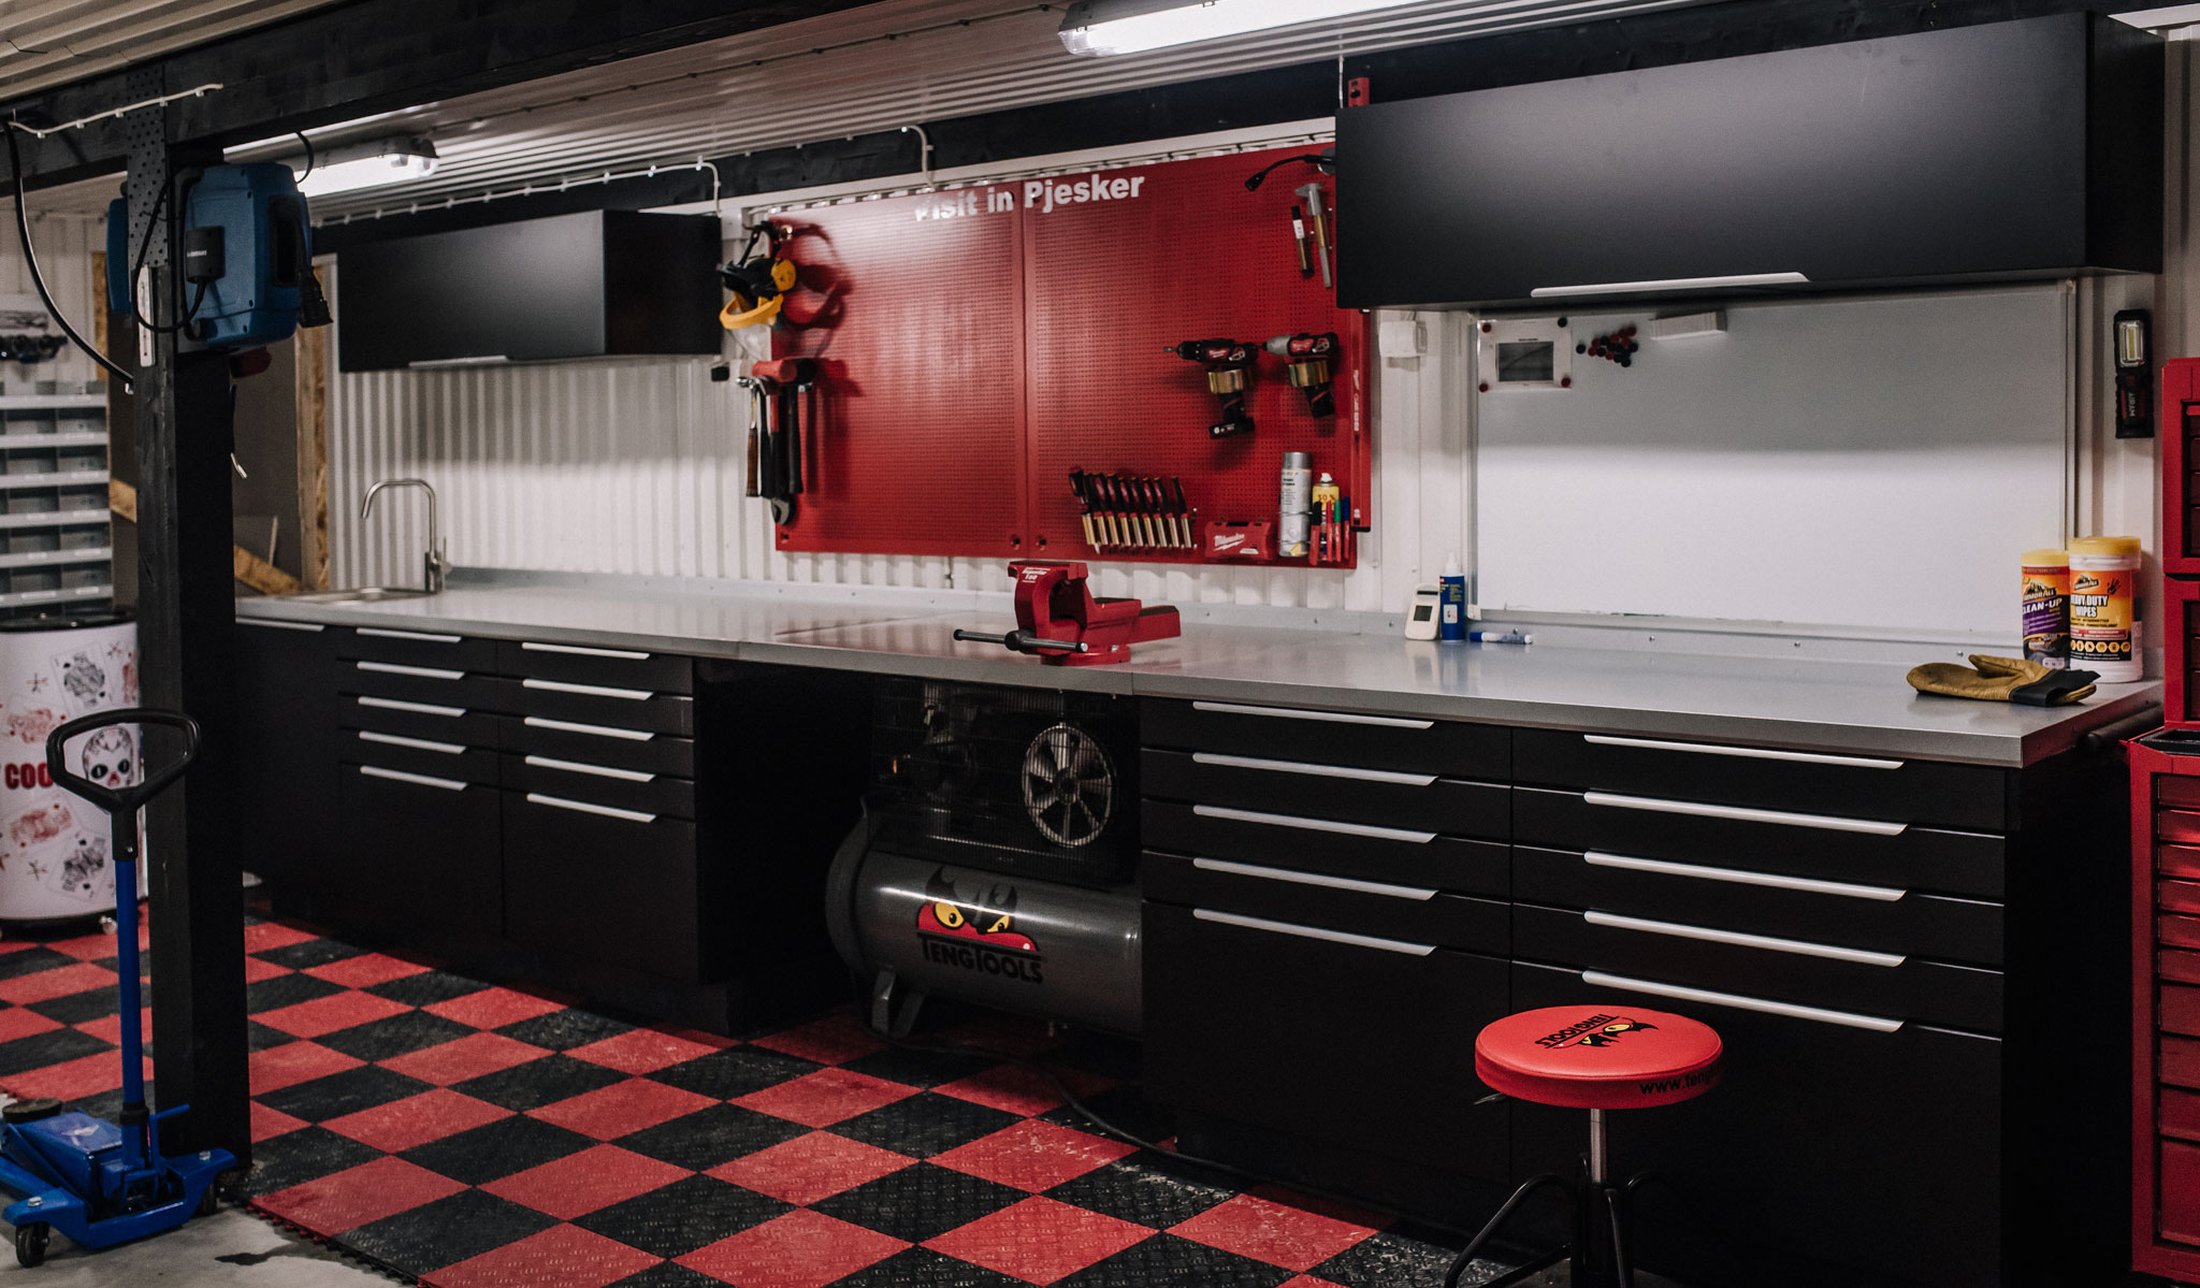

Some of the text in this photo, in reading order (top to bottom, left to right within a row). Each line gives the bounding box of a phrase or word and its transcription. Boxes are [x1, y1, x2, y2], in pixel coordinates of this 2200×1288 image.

[987, 186, 1014, 213] in
[1024, 174, 1145, 214] Pjesker
[2022, 598, 2062, 614] LEAN-UP
[2087, 595, 2107, 606] DUTY
[5, 762, 54, 790] COO
